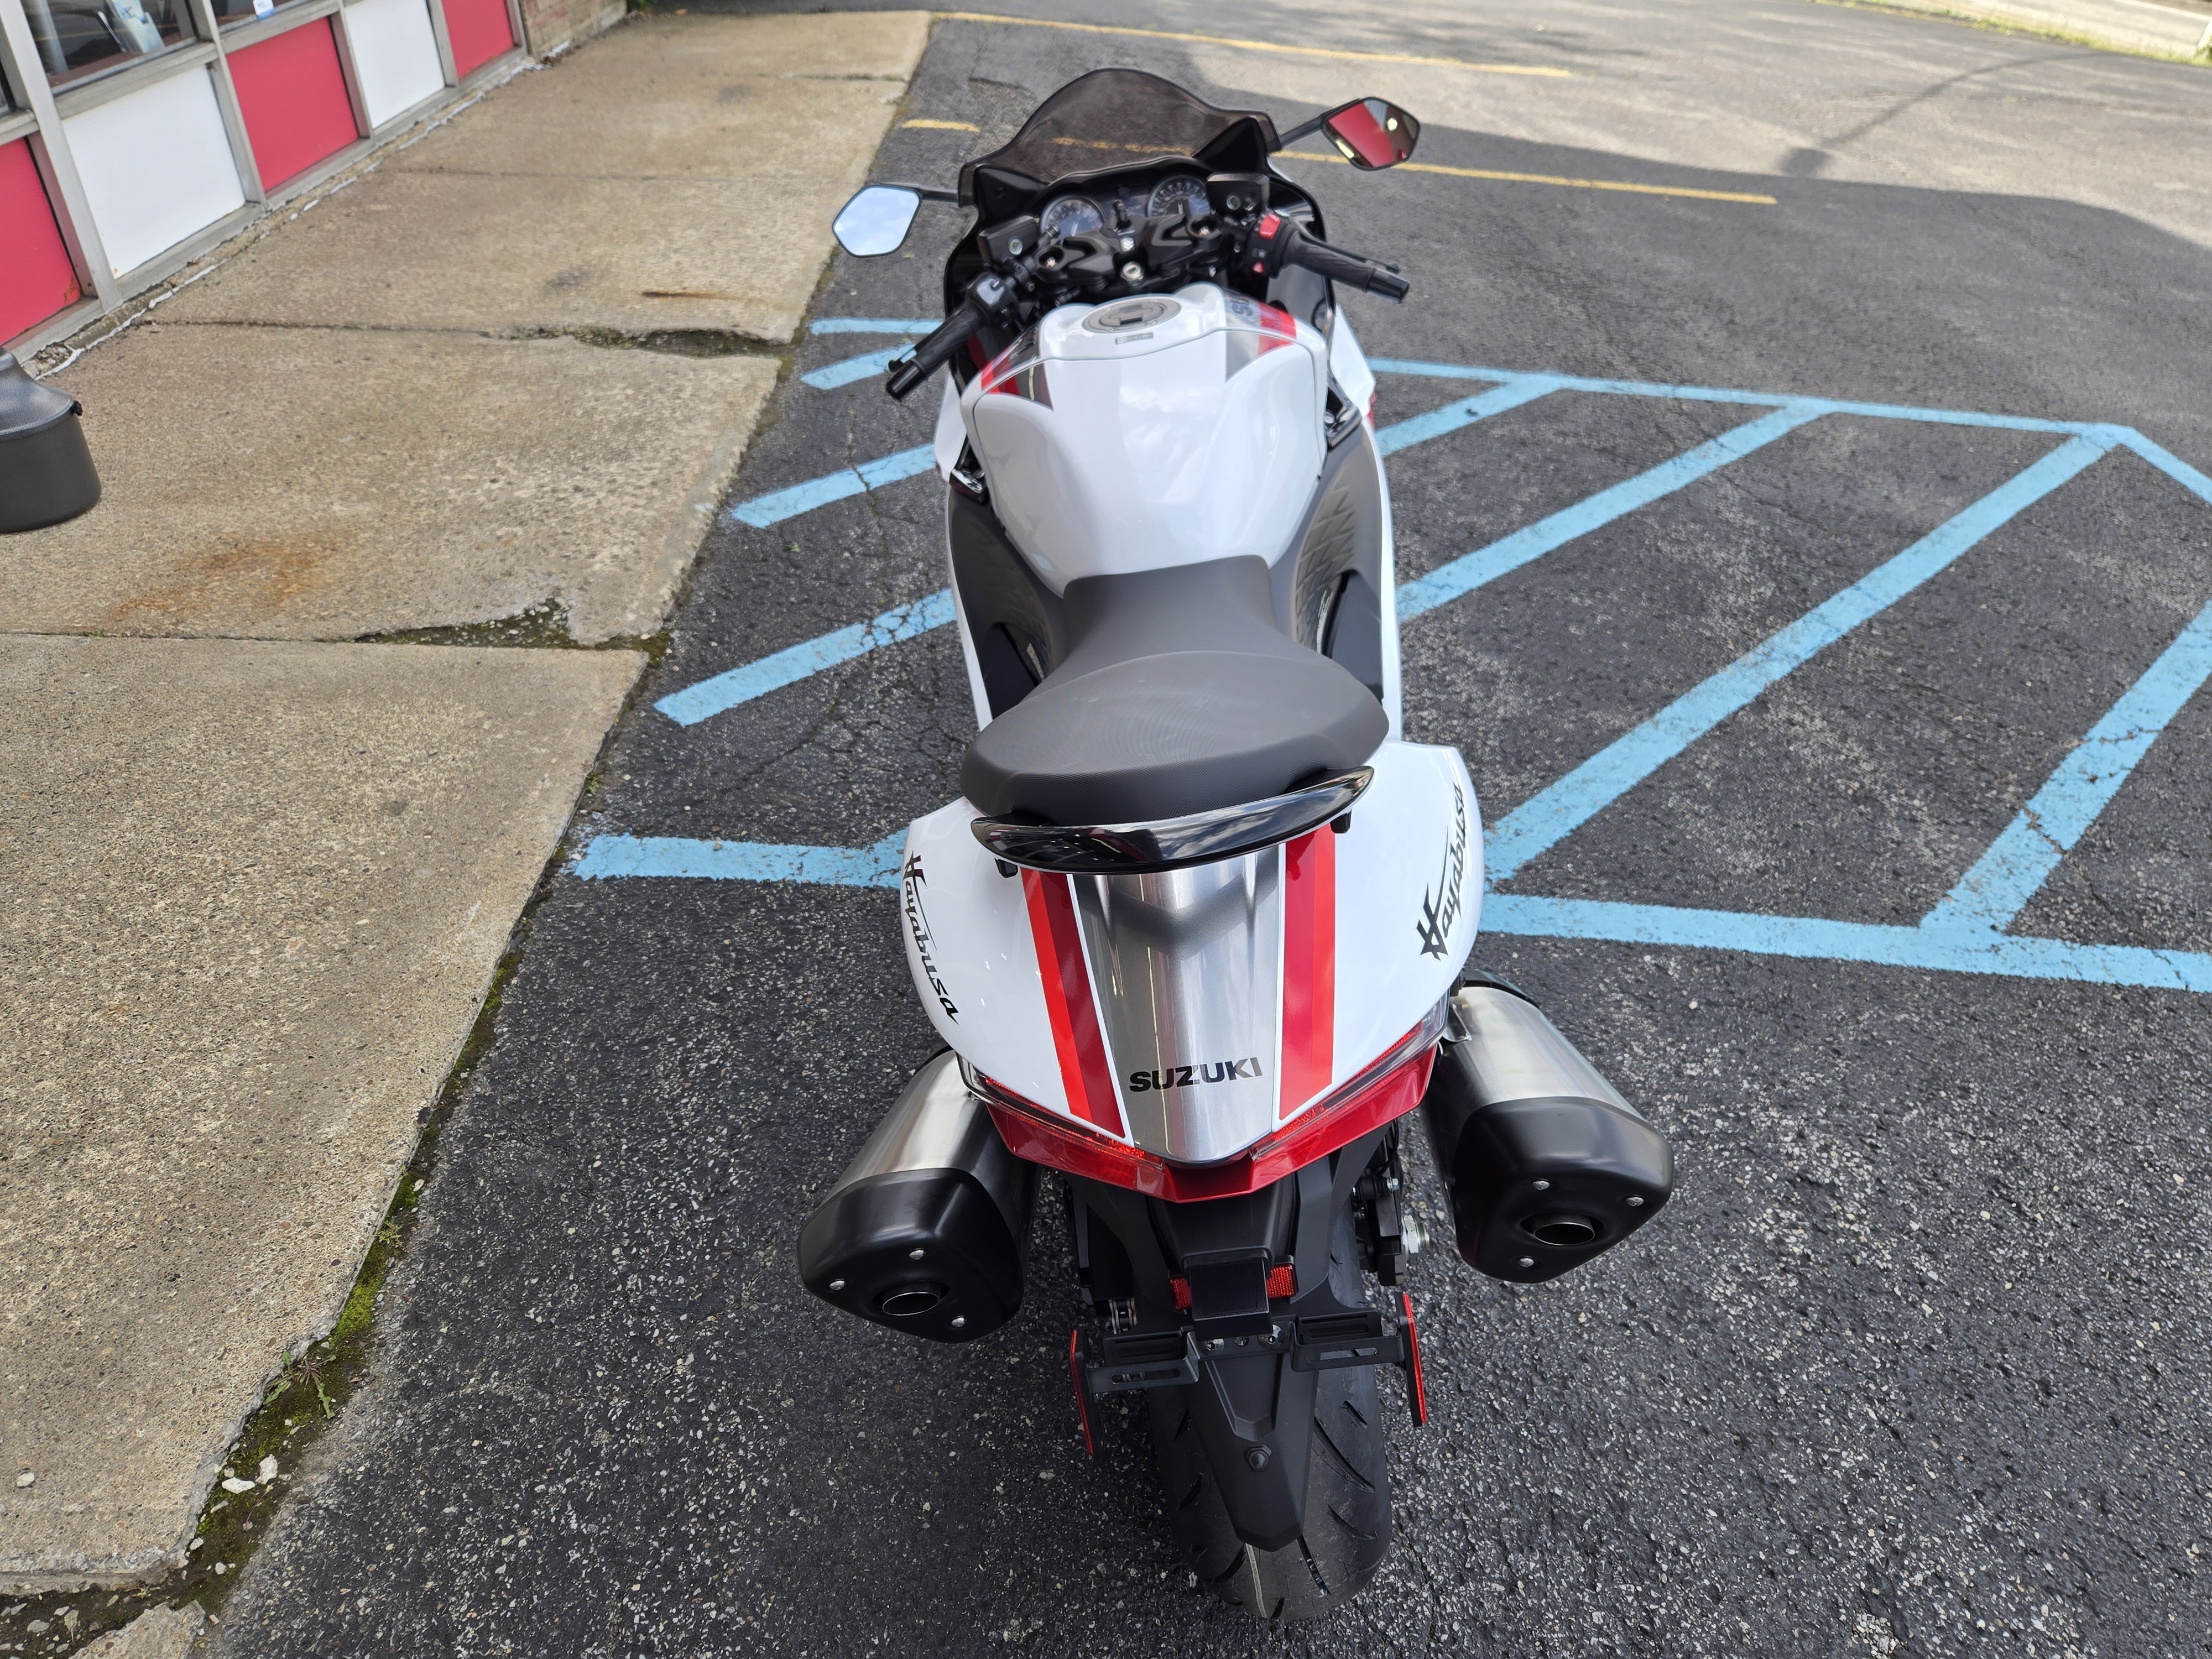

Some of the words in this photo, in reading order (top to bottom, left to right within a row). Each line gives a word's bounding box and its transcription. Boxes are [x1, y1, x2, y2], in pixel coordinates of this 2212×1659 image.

[902, 850, 960, 1026] Hayabusa
[1416, 781, 1466, 961] Hayabusa
[1129, 1057, 1263, 1092] SUZUKI
